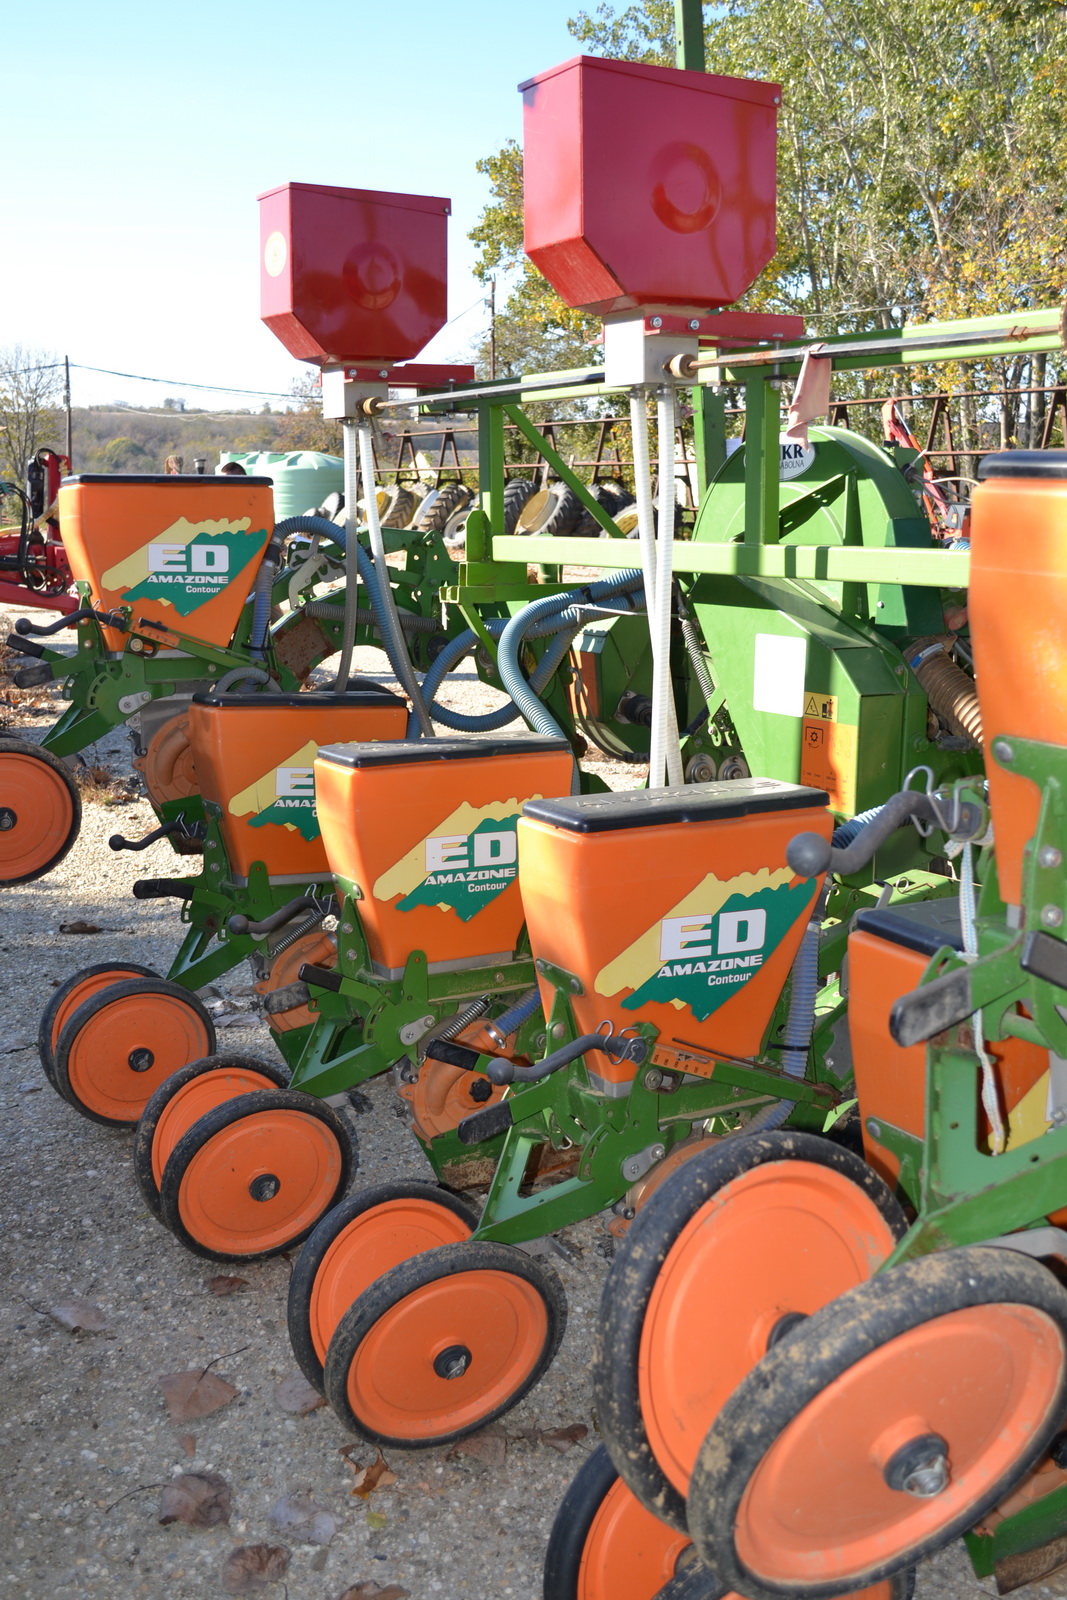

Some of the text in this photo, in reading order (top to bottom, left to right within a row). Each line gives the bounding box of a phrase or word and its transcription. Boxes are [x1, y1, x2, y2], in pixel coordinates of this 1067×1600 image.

[148, 544, 229, 573] ED
[147, 575, 229, 584] AMAZONE
[185, 585, 220, 593] Contour
[425, 830, 517, 872] ED
[424, 867, 516, 886] AMAZONE
[467, 882, 507, 893] Contour
[660, 908, 767, 961] ED
[657, 954, 763, 978] AMAZONE
[707, 972, 752, 986] Contour
